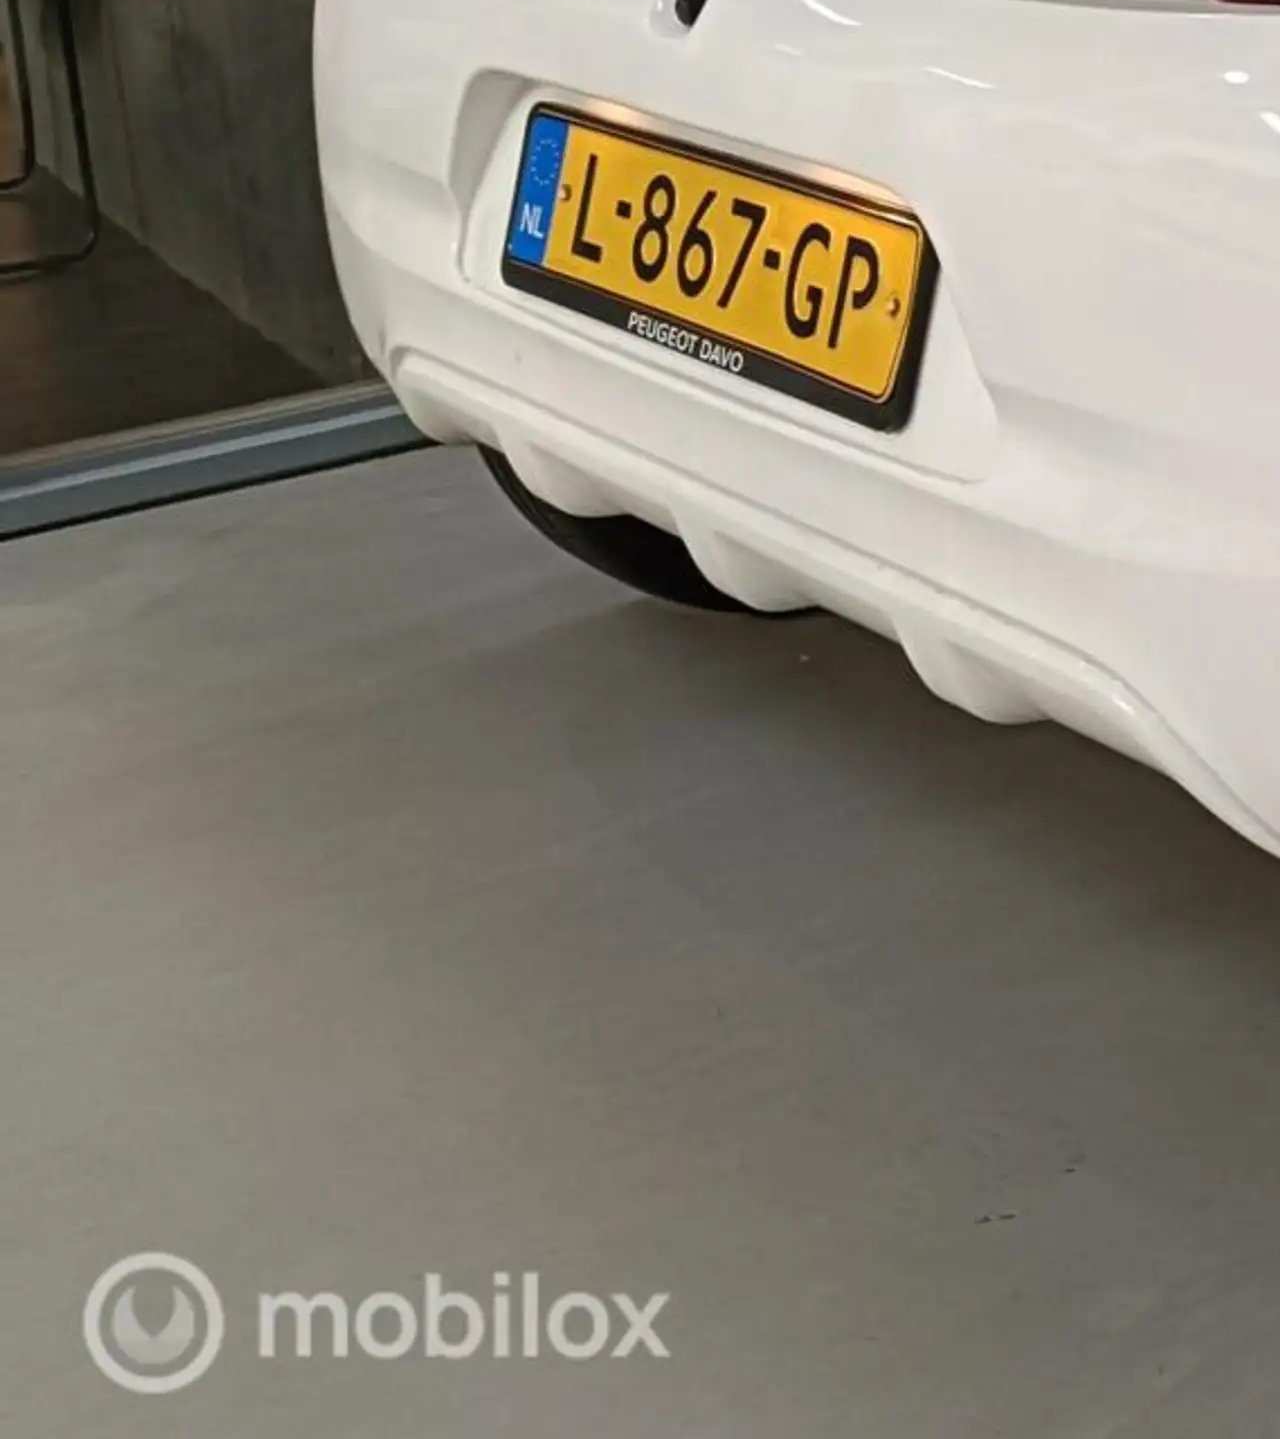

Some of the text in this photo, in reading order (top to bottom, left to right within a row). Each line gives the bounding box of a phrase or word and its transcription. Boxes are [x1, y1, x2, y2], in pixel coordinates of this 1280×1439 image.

[519, 201, 544, 238] NL
[570, 153, 879, 350] L-867-GP
[626, 310, 744, 373] PEUGEOT DAVO
